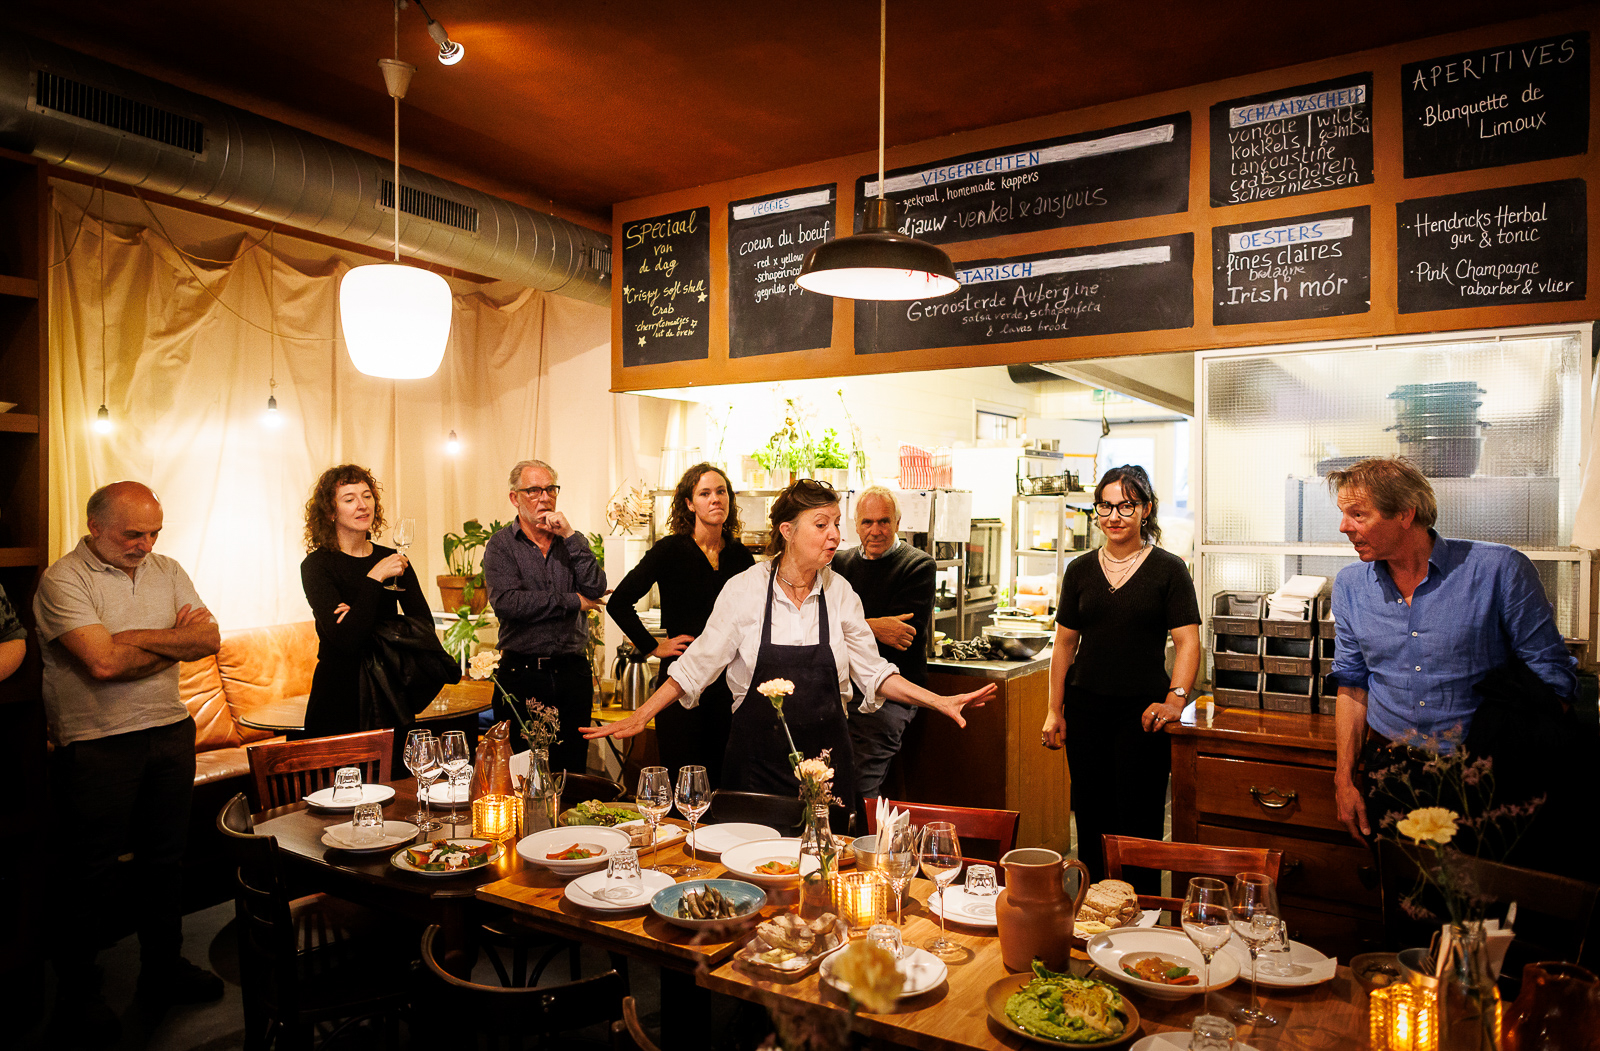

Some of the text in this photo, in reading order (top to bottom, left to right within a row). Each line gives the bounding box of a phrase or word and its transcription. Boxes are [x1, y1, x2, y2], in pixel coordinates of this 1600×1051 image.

[1412, 39, 1575, 91] APERITIVES
[1423, 82, 1544, 128] Blanquette de
[1480, 111, 1547, 139] Limoux
[921, 151, 1040, 186] VISGERECHTEN
[946, 178, 996, 200] homemade
[1001, 171, 1040, 192] kappers
[778, 229, 794, 246] du
[798, 220, 830, 244] boeuf
[1414, 202, 1548, 238] Hendricks Herbal
[653, 244, 673, 255] van
[1240, 223, 1323, 250] OESTERS
[1450, 227, 1541, 250] gin & tonic
[756, 255, 770, 269] red
[1277, 242, 1343, 265] claires
[639, 257, 679, 277] de dag
[1416, 258, 1540, 286] Pink Champagne
[626, 278, 707, 307] Crispy soft shell
[755, 283, 787, 303] gegrilde
[1227, 279, 1288, 305] Irish
[1460, 278, 1574, 297] rabarber & vlier
[652, 302, 675, 316] Crab
[907, 282, 1099, 322] Geroosterde Aubergine
[962, 309, 992, 325] salsa
[1038, 318, 1069, 332] brood
